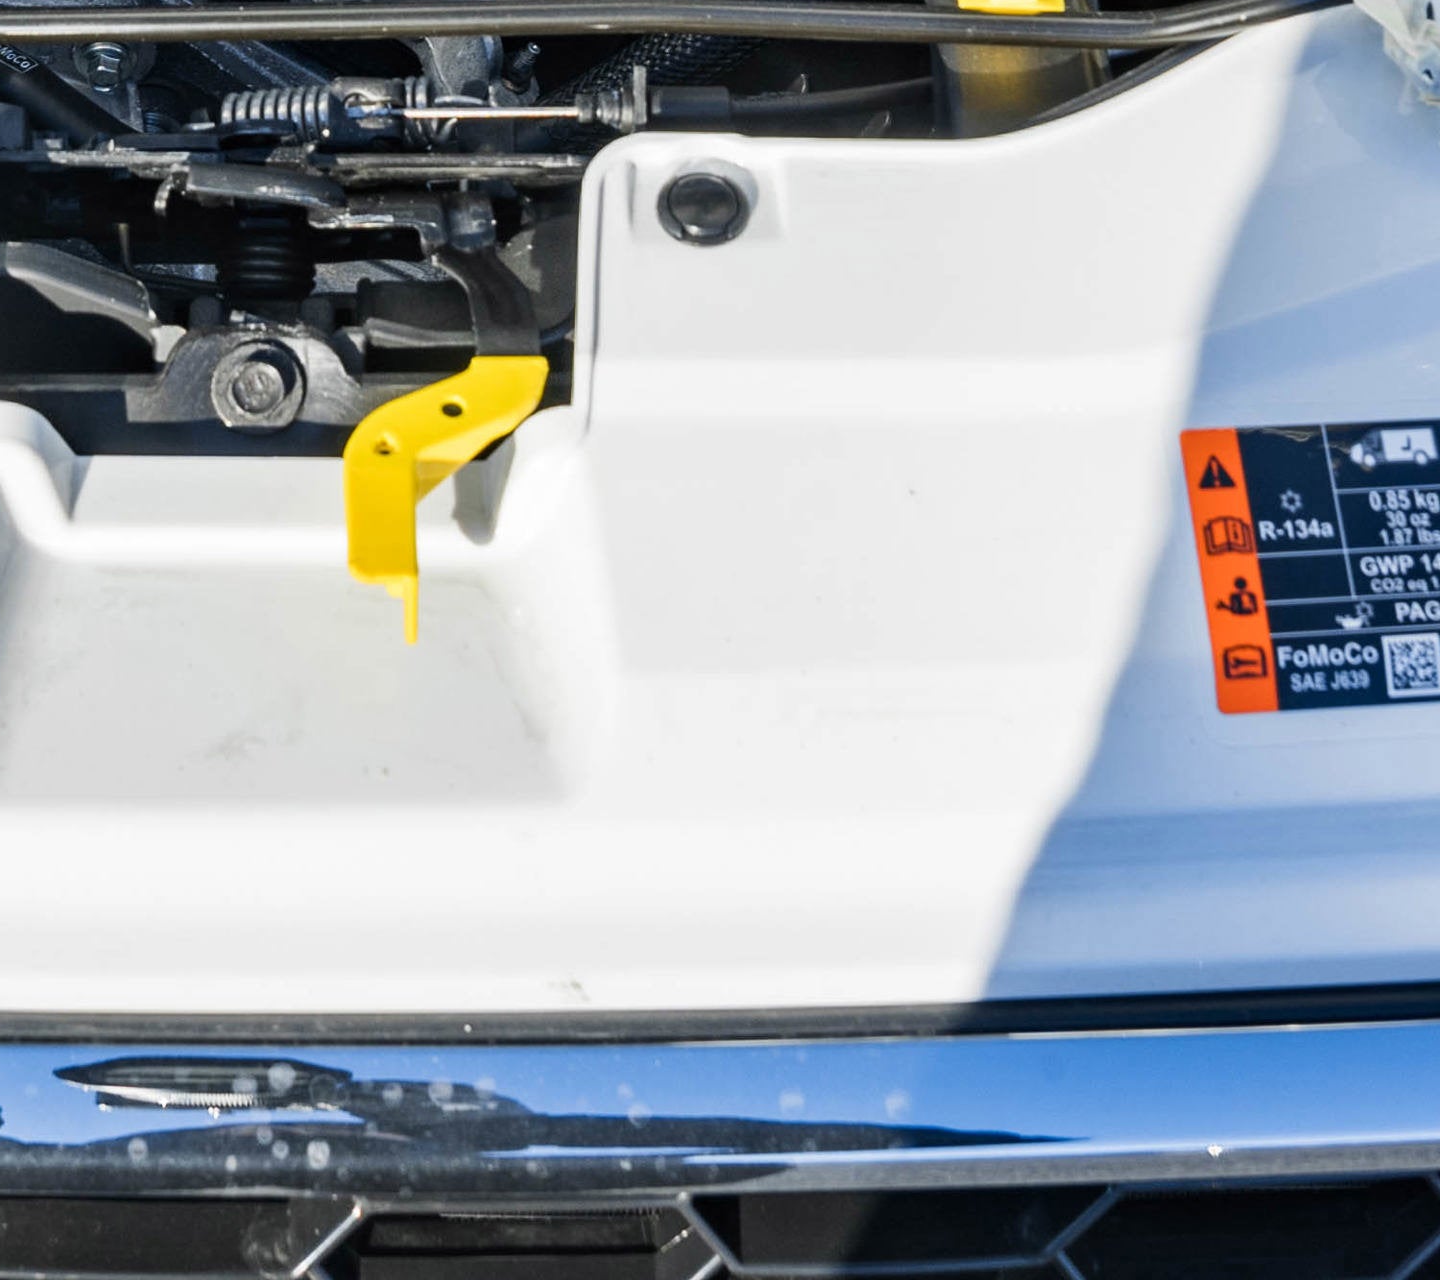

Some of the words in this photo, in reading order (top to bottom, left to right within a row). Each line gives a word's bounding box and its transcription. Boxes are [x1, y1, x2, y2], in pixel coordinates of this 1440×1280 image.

[1369, 490, 1411, 511] 0.85
[1414, 489, 1440, 514] kg
[1258, 518, 1334, 541] R-134a
[1385, 510, 1407, 528] 30
[1409, 513, 1431, 527] oz
[1379, 528, 1413, 545] 1.87
[1359, 554, 1414, 577] GWP
[1370, 577, 1405, 593] CO2
[1407, 579, 1429, 594] eq
[1276, 641, 1380, 670] FoMoCo
[1289, 671, 1328, 692] SAE
[1330, 669, 1371, 691] J639
